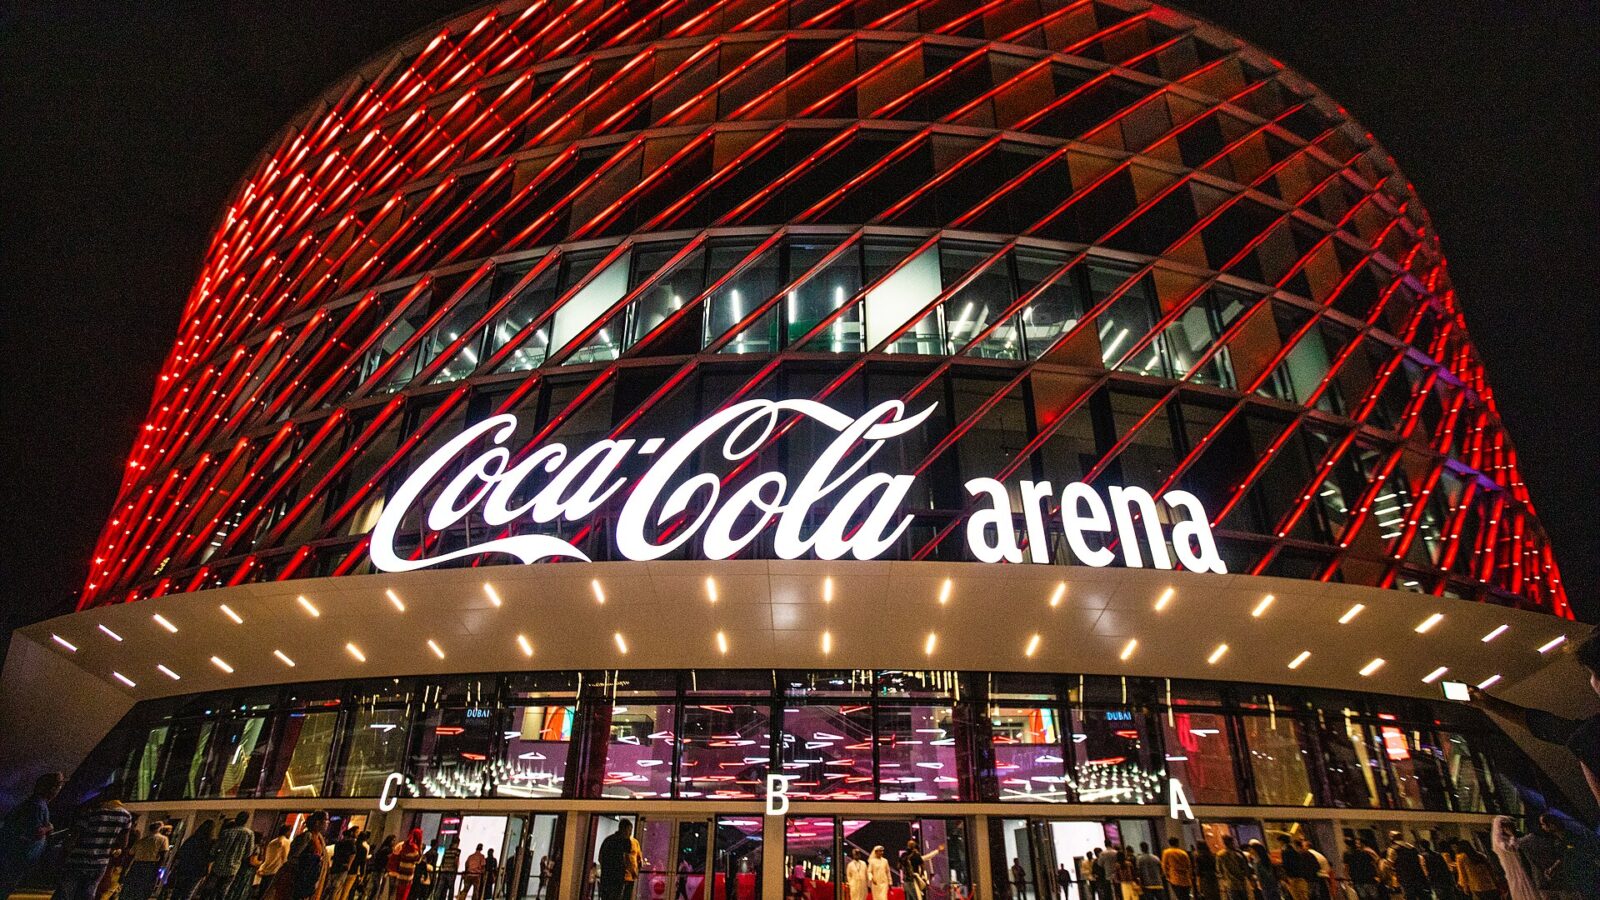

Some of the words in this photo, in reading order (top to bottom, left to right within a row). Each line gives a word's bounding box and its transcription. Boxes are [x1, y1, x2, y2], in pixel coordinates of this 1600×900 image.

[370, 398, 938, 572] Coca-Cola
[964, 477, 1228, 574] arena
[467, 709, 490, 718] DUBAI
[1106, 711, 1132, 720] DUBAI
[380, 772, 403, 812] C
[766, 774, 789, 815] B
[1169, 778, 1195, 819] A
